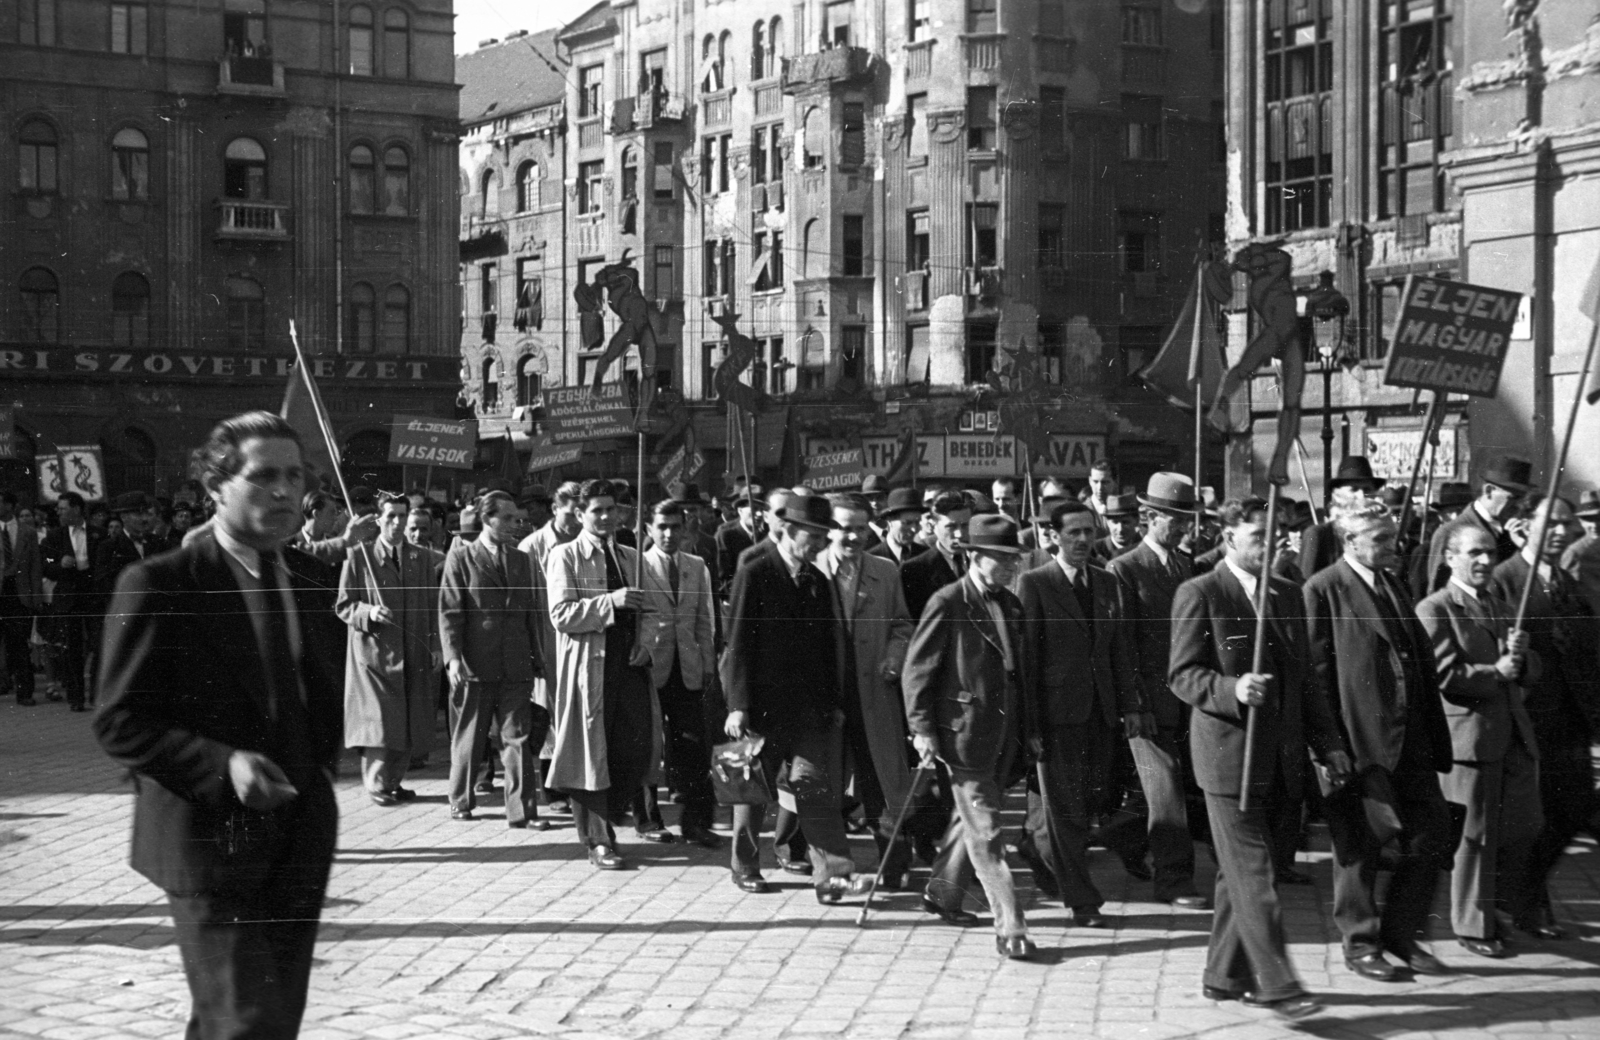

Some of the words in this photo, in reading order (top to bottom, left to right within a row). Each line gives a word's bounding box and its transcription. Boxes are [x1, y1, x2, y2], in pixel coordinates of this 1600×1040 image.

[1409, 279, 1519, 322] ÉLJEN
[1398, 319, 1504, 357] MAGYAR
[548, 384, 623, 405] FEGYHZBA
[407, 419, 467, 436] ÉLJENEK
[396, 444, 469, 463] VASASOK
[950, 441, 1013, 458] BENEDEK
[802, 471, 862, 490] GAZDAGOK
